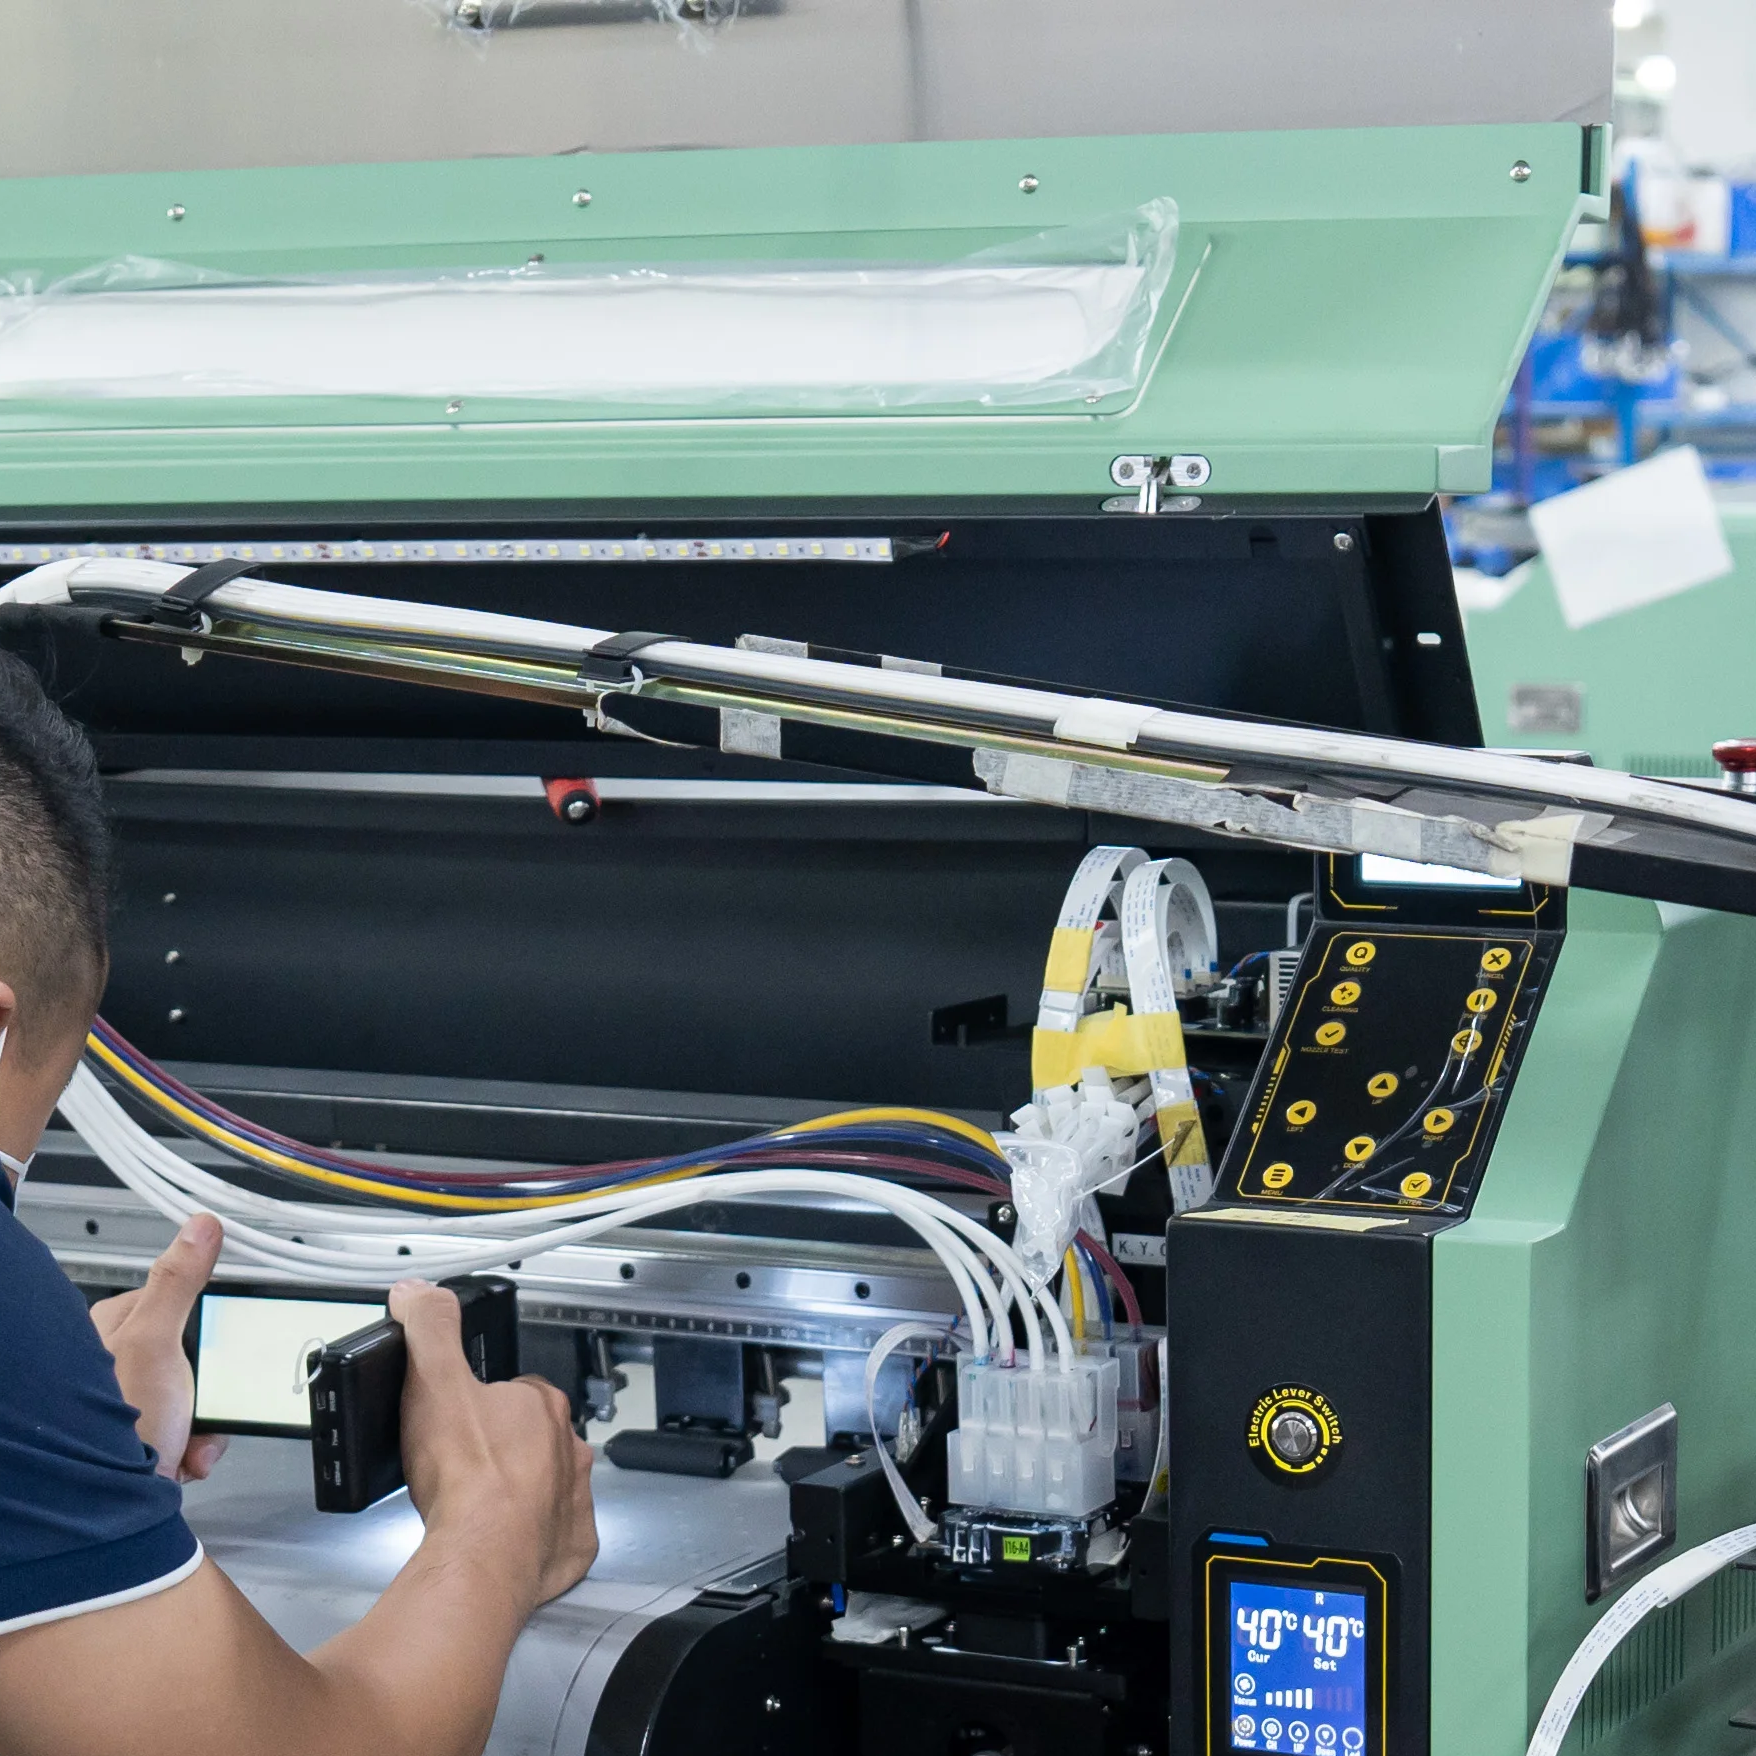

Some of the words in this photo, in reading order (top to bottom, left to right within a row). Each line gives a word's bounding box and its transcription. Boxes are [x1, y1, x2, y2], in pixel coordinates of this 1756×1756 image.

[1353, 947, 1368, 959] Q
[1322, 1005, 1359, 1013] CLEANING
[1248, 1397, 1273, 1447] Electric
[1273, 1388, 1312, 1400] Lever
[1314, 1395, 1343, 1444] Switch
[1315, 1592, 1324, 1605] R
[1247, 1650, 1271, 1664] Cur
[1313, 1657, 1337, 1671] Set
[1234, 1735, 1256, 1748] Power
